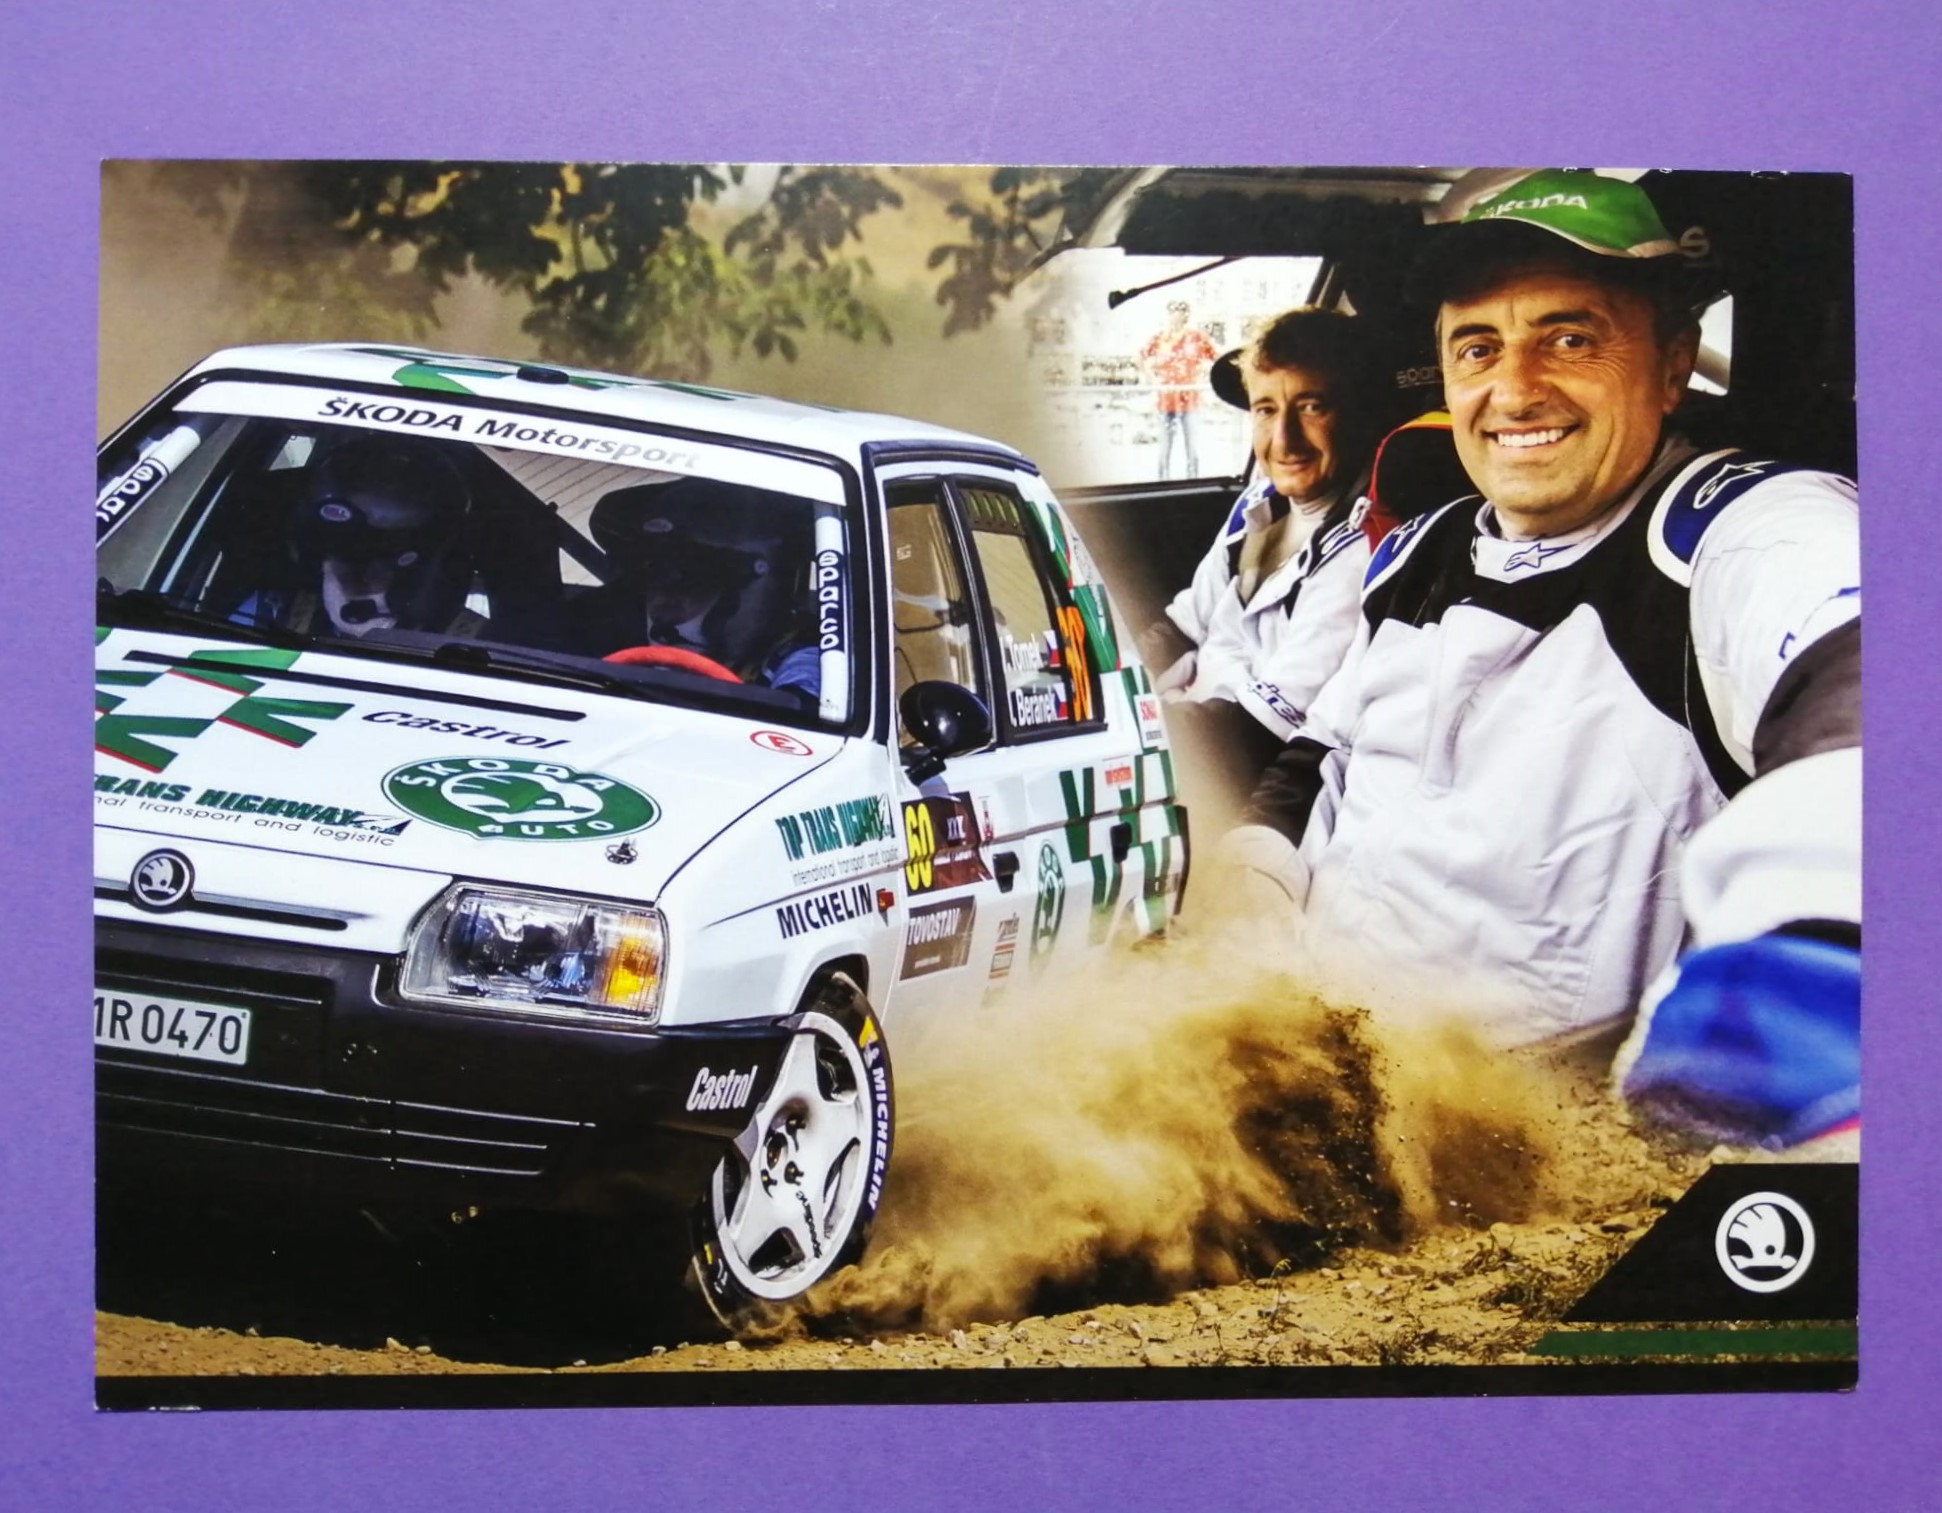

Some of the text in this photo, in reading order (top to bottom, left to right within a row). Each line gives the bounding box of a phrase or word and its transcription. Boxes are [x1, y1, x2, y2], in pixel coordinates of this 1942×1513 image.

[317, 397, 702, 469] ŠKODA Motorsport
[817, 551, 841, 651] sparco
[361, 710, 571, 750] Castrol
[94, 773, 364, 826] RANS HIGHWAY
[138, 799, 242, 823] transport
[254, 817, 302, 832] and
[313, 825, 396, 848] logistic
[478, 819, 615, 836] AUTO
[799, 805, 843, 855] TRANS
[904, 802, 936, 891] 60
[776, 882, 873, 940] MICHELIN
[141, 1003, 243, 1056] 0470
[686, 1064, 759, 1112] Castrol
[866, 1066, 889, 1209] MICHELIN
